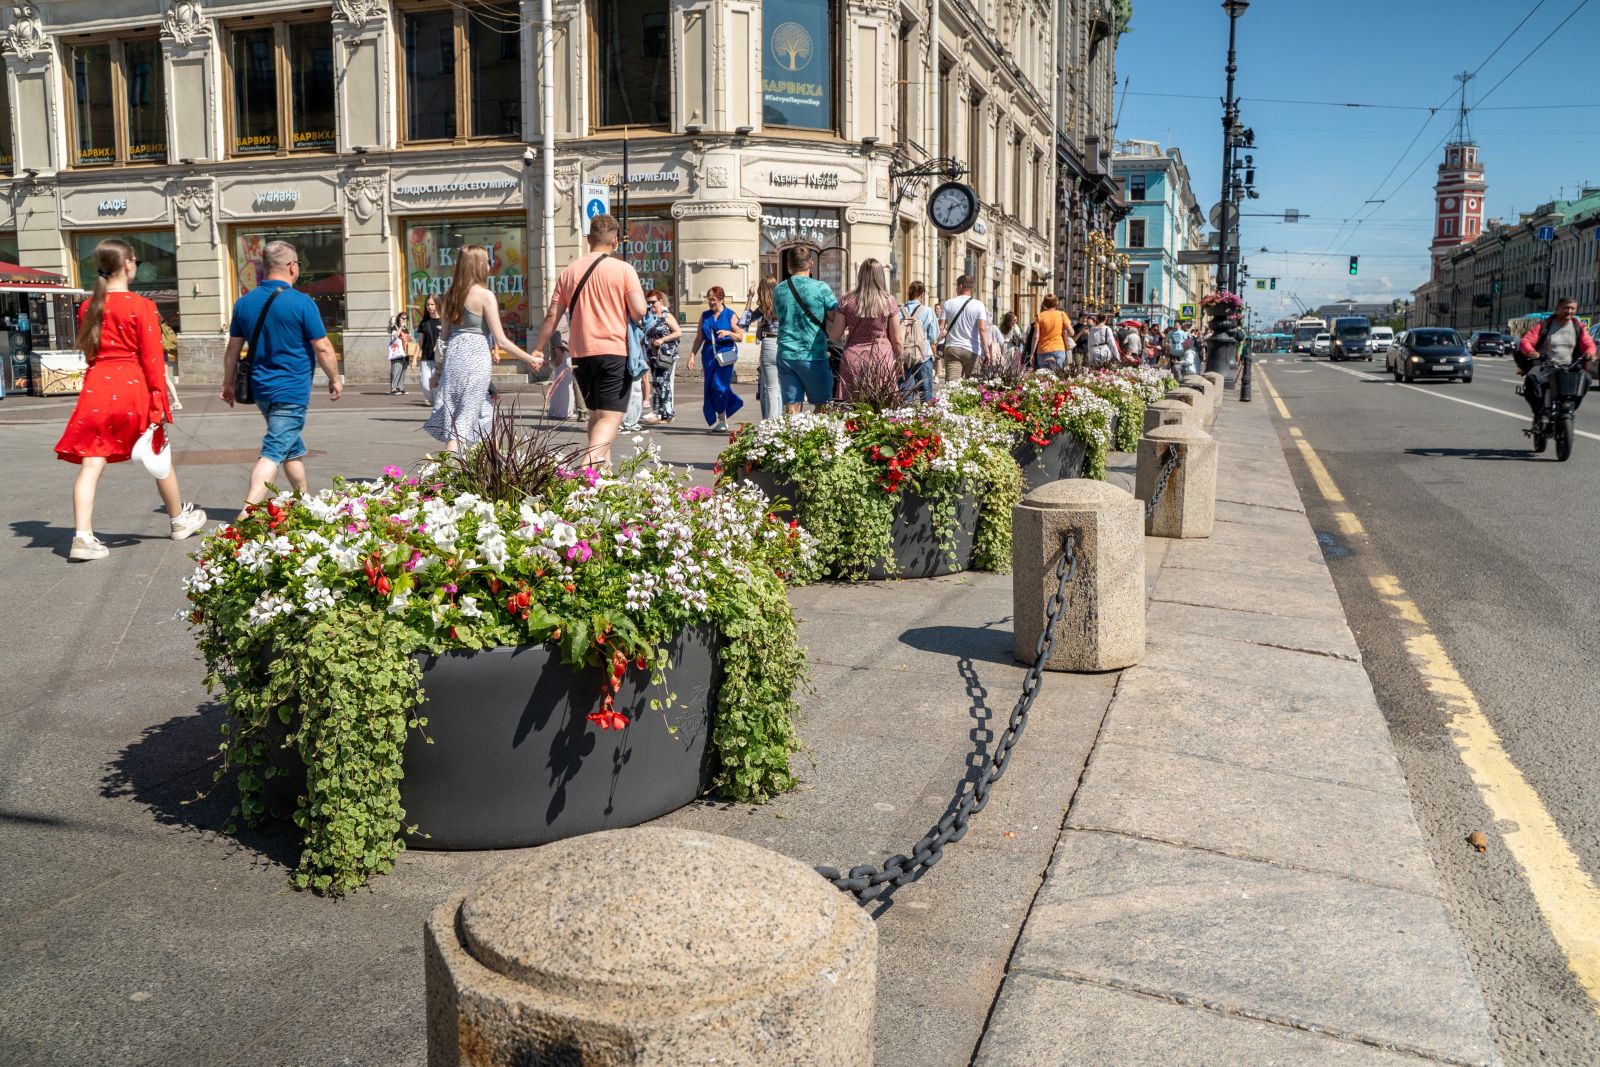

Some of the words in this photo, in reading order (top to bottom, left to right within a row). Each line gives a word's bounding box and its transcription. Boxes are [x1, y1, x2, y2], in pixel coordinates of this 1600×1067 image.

[396, 184, 443, 195] СЛАДОСТИ
[459, 181, 487, 190] ВСЕГО
[489, 180, 516, 189] МИРА
[99, 199, 127, 210] КАФЕ
[763, 215, 796, 226] STARS
[800, 218, 840, 228] COFFEE
[412, 274, 525, 297] МАРЛАД
